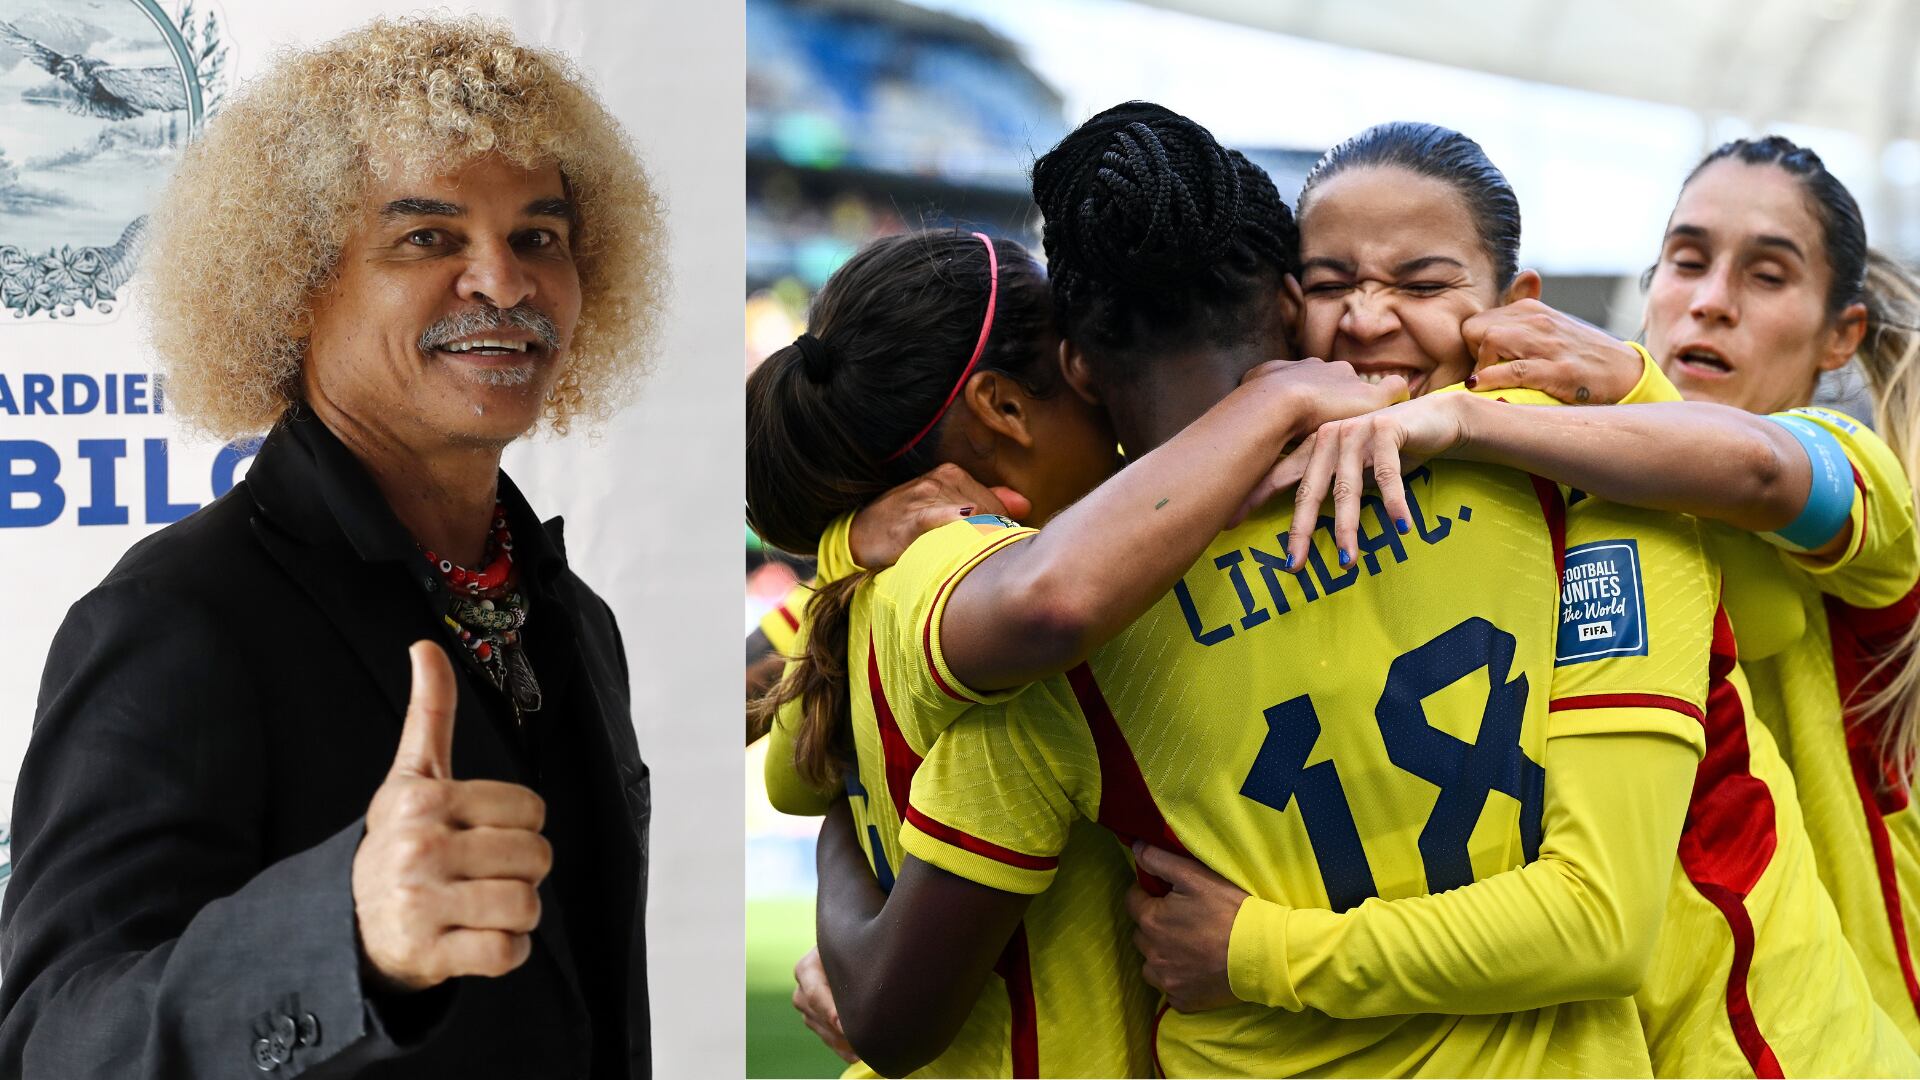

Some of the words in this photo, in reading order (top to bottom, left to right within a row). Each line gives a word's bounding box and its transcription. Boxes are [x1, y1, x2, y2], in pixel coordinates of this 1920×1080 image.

[1562, 560, 1618, 585] OOTBALL
[1562, 575, 1621, 605] UNITES
[1562, 604, 1583, 624] the
[1584, 596, 1626, 620] World
[1583, 625, 1608, 637] FIFA
[1239, 616, 1545, 914] 18
